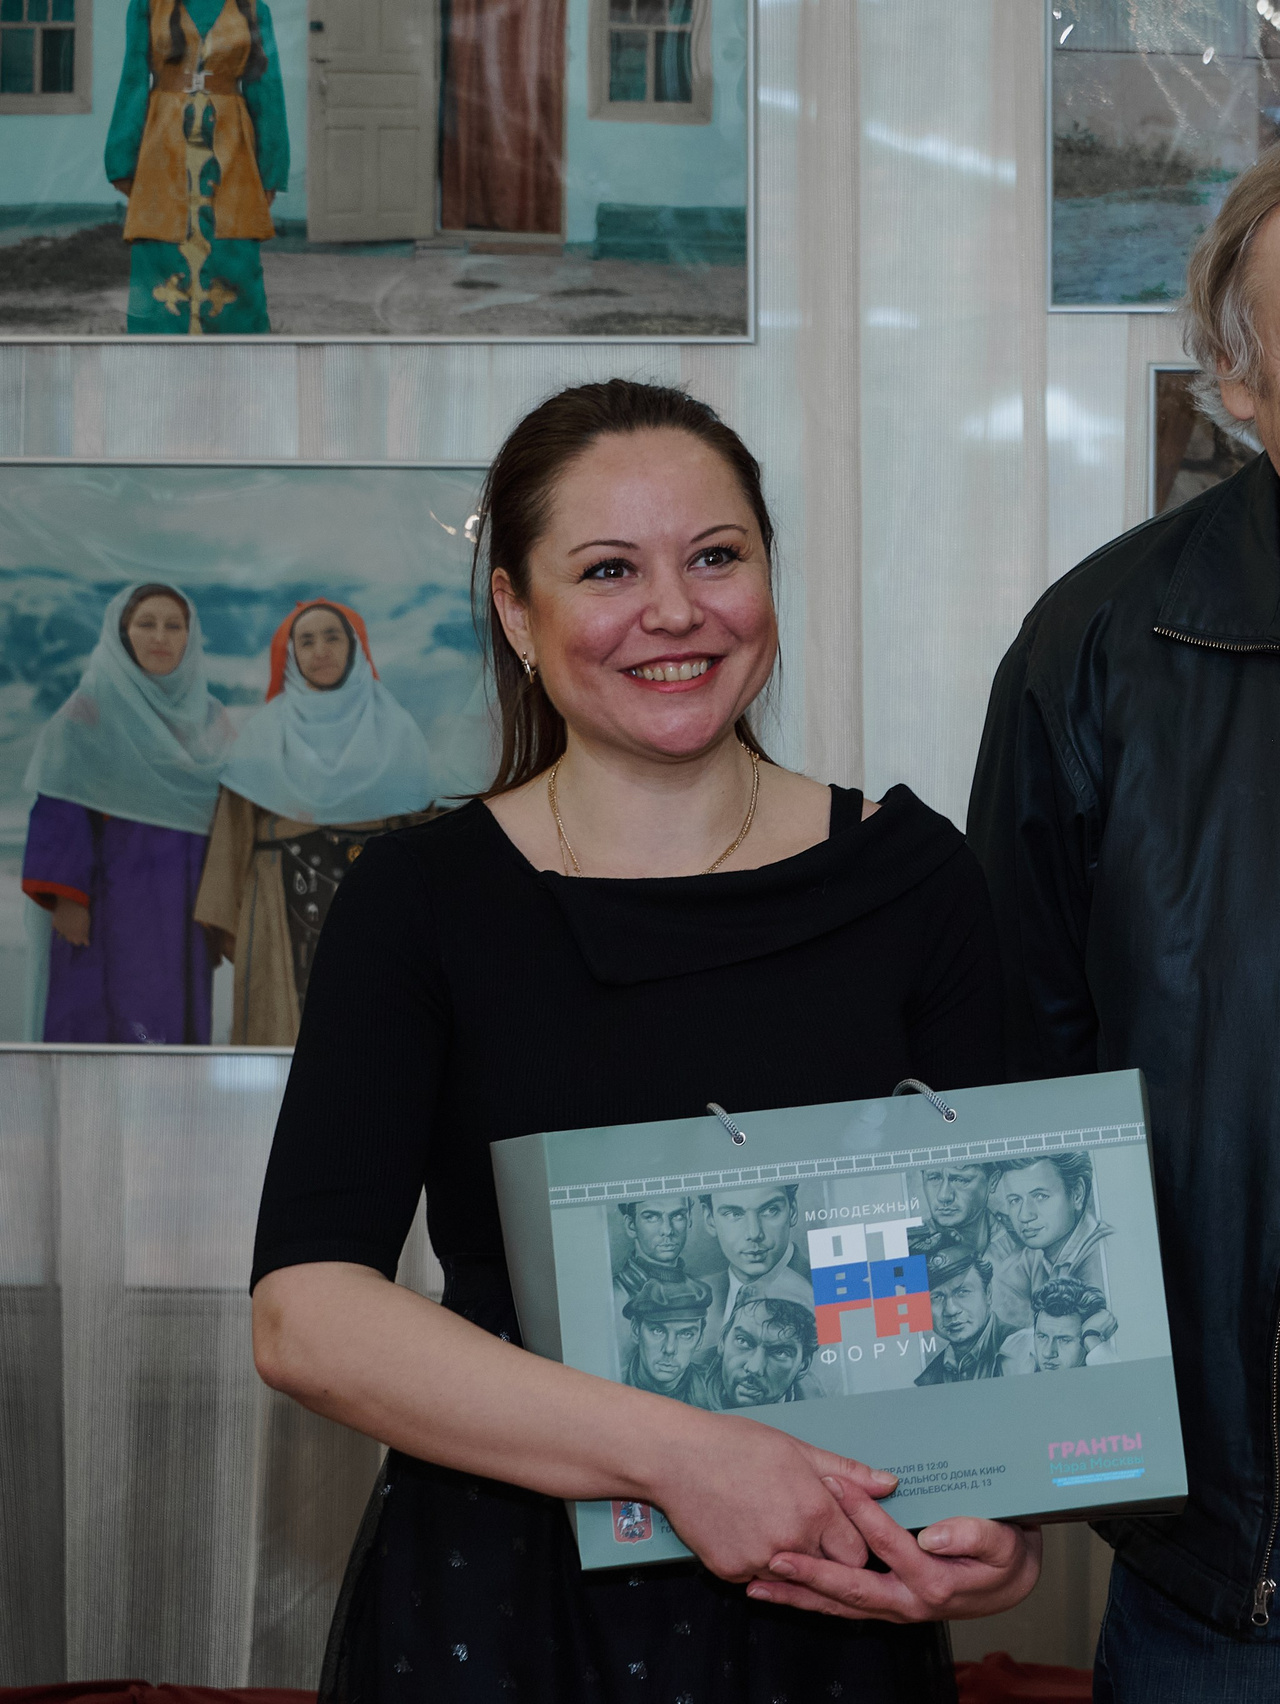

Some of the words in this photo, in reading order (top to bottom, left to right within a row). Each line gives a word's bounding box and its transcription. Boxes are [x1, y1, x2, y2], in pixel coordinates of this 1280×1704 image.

[805, 1197, 920, 1221] МОЛОДЕЖНЫЙ
[820, 1337, 937, 1364] ФОРУМ
[1047, 1432, 1142, 1461] ГРАНТЫ
[880, 1464, 915, 1474] РАЛЯ
[917, 1463, 924, 1472] В
[926, 1461, 949, 1470] 12:00
[898, 1472, 948, 1485] РАЛЬНОГО
[949, 1468, 978, 1481] ДОМА
[979, 1464, 1006, 1476] КИНО
[1049, 1462, 1087, 1474] Мэра
[1089, 1456, 1144, 1470] Москвы
[982, 1478, 992, 1487] 13
